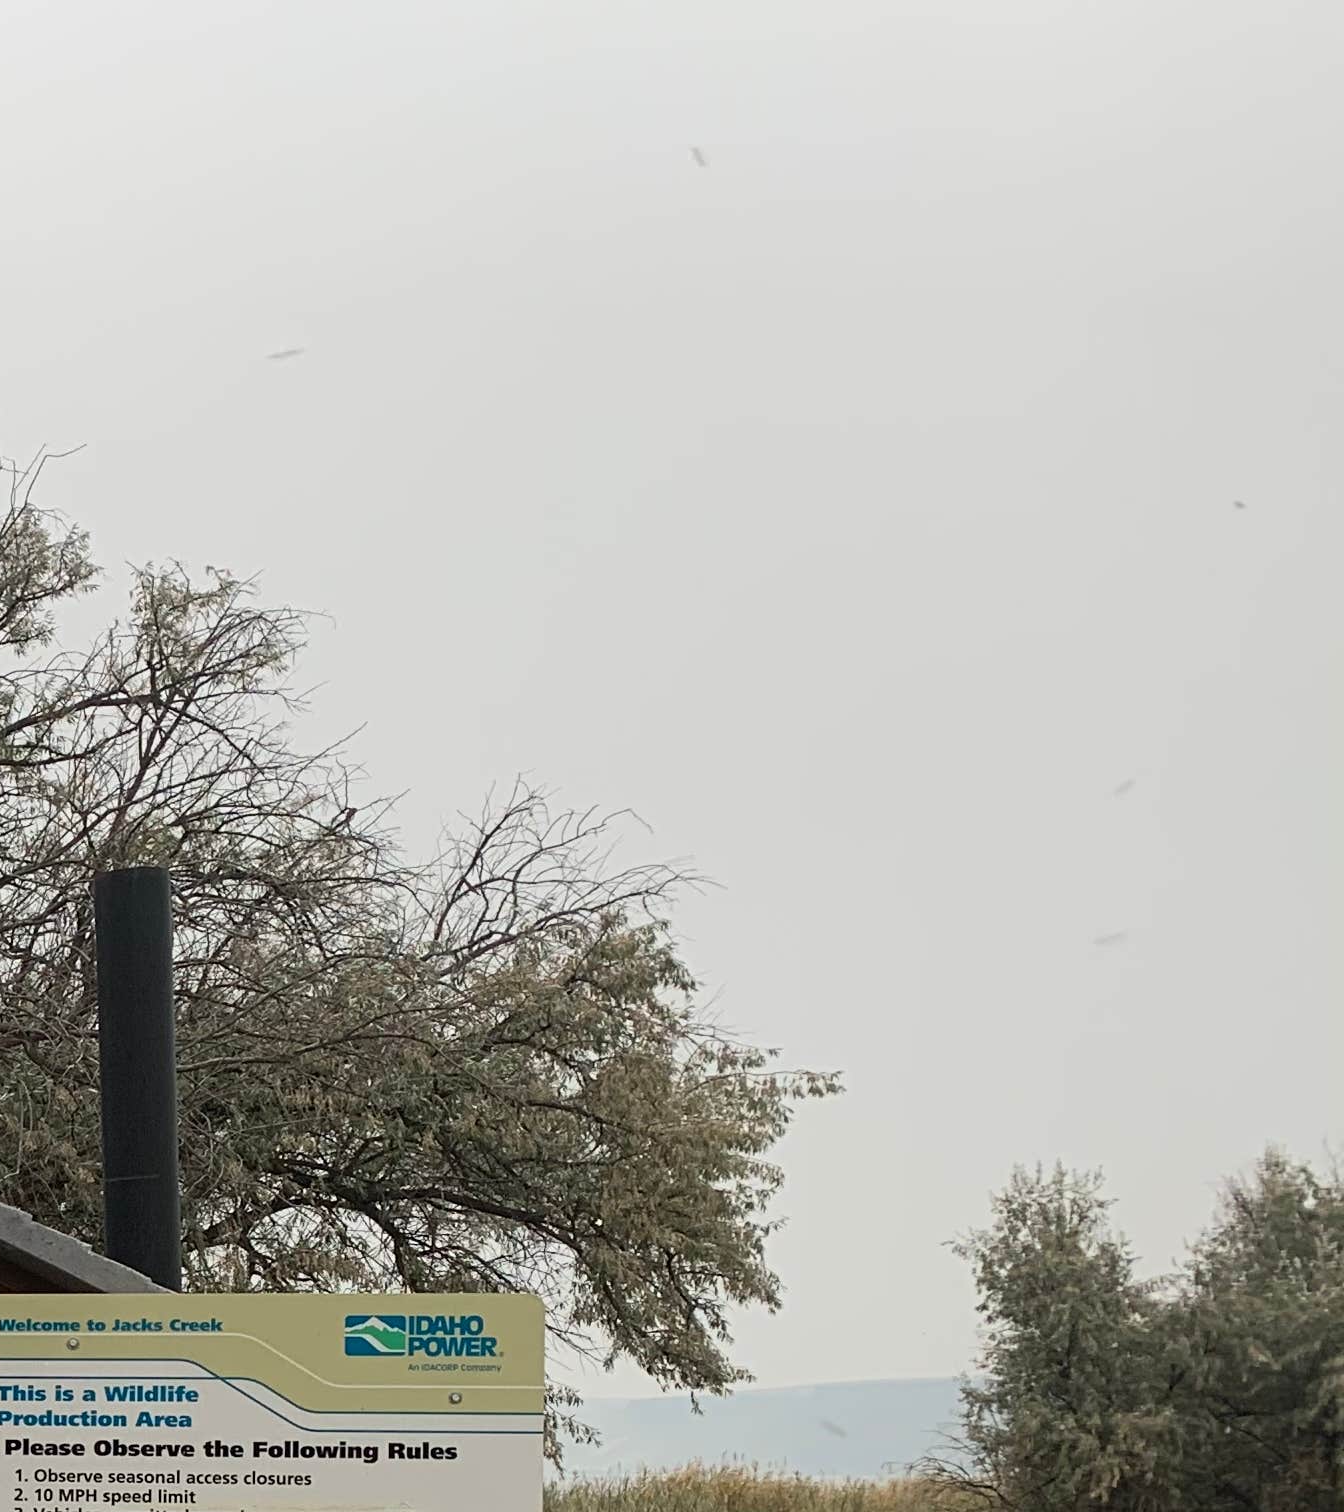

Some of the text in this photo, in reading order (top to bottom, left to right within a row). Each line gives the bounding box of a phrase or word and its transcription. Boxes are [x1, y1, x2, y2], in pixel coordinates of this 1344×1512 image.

[86, 1319, 106, 1332] to
[111, 1317, 163, 1332] Jacks
[168, 1318, 223, 1332] Creek
[408, 1315, 484, 1336] IDAHO
[407, 1336, 497, 1357] POWER
[459, 1363, 502, 1372] Company
[54, 1384, 74, 1402] is
[81, 1389, 96, 1402] a
[103, 1385, 199, 1402] Wildlife
[134, 1411, 192, 1427] Area
[4, 1437, 458, 1463] Please Observe the Following Rules
[14, 1467, 312, 1486] 1. Observe seasonal access closures
[13, 1487, 196, 1505] 2. 10 MPH speed limit
